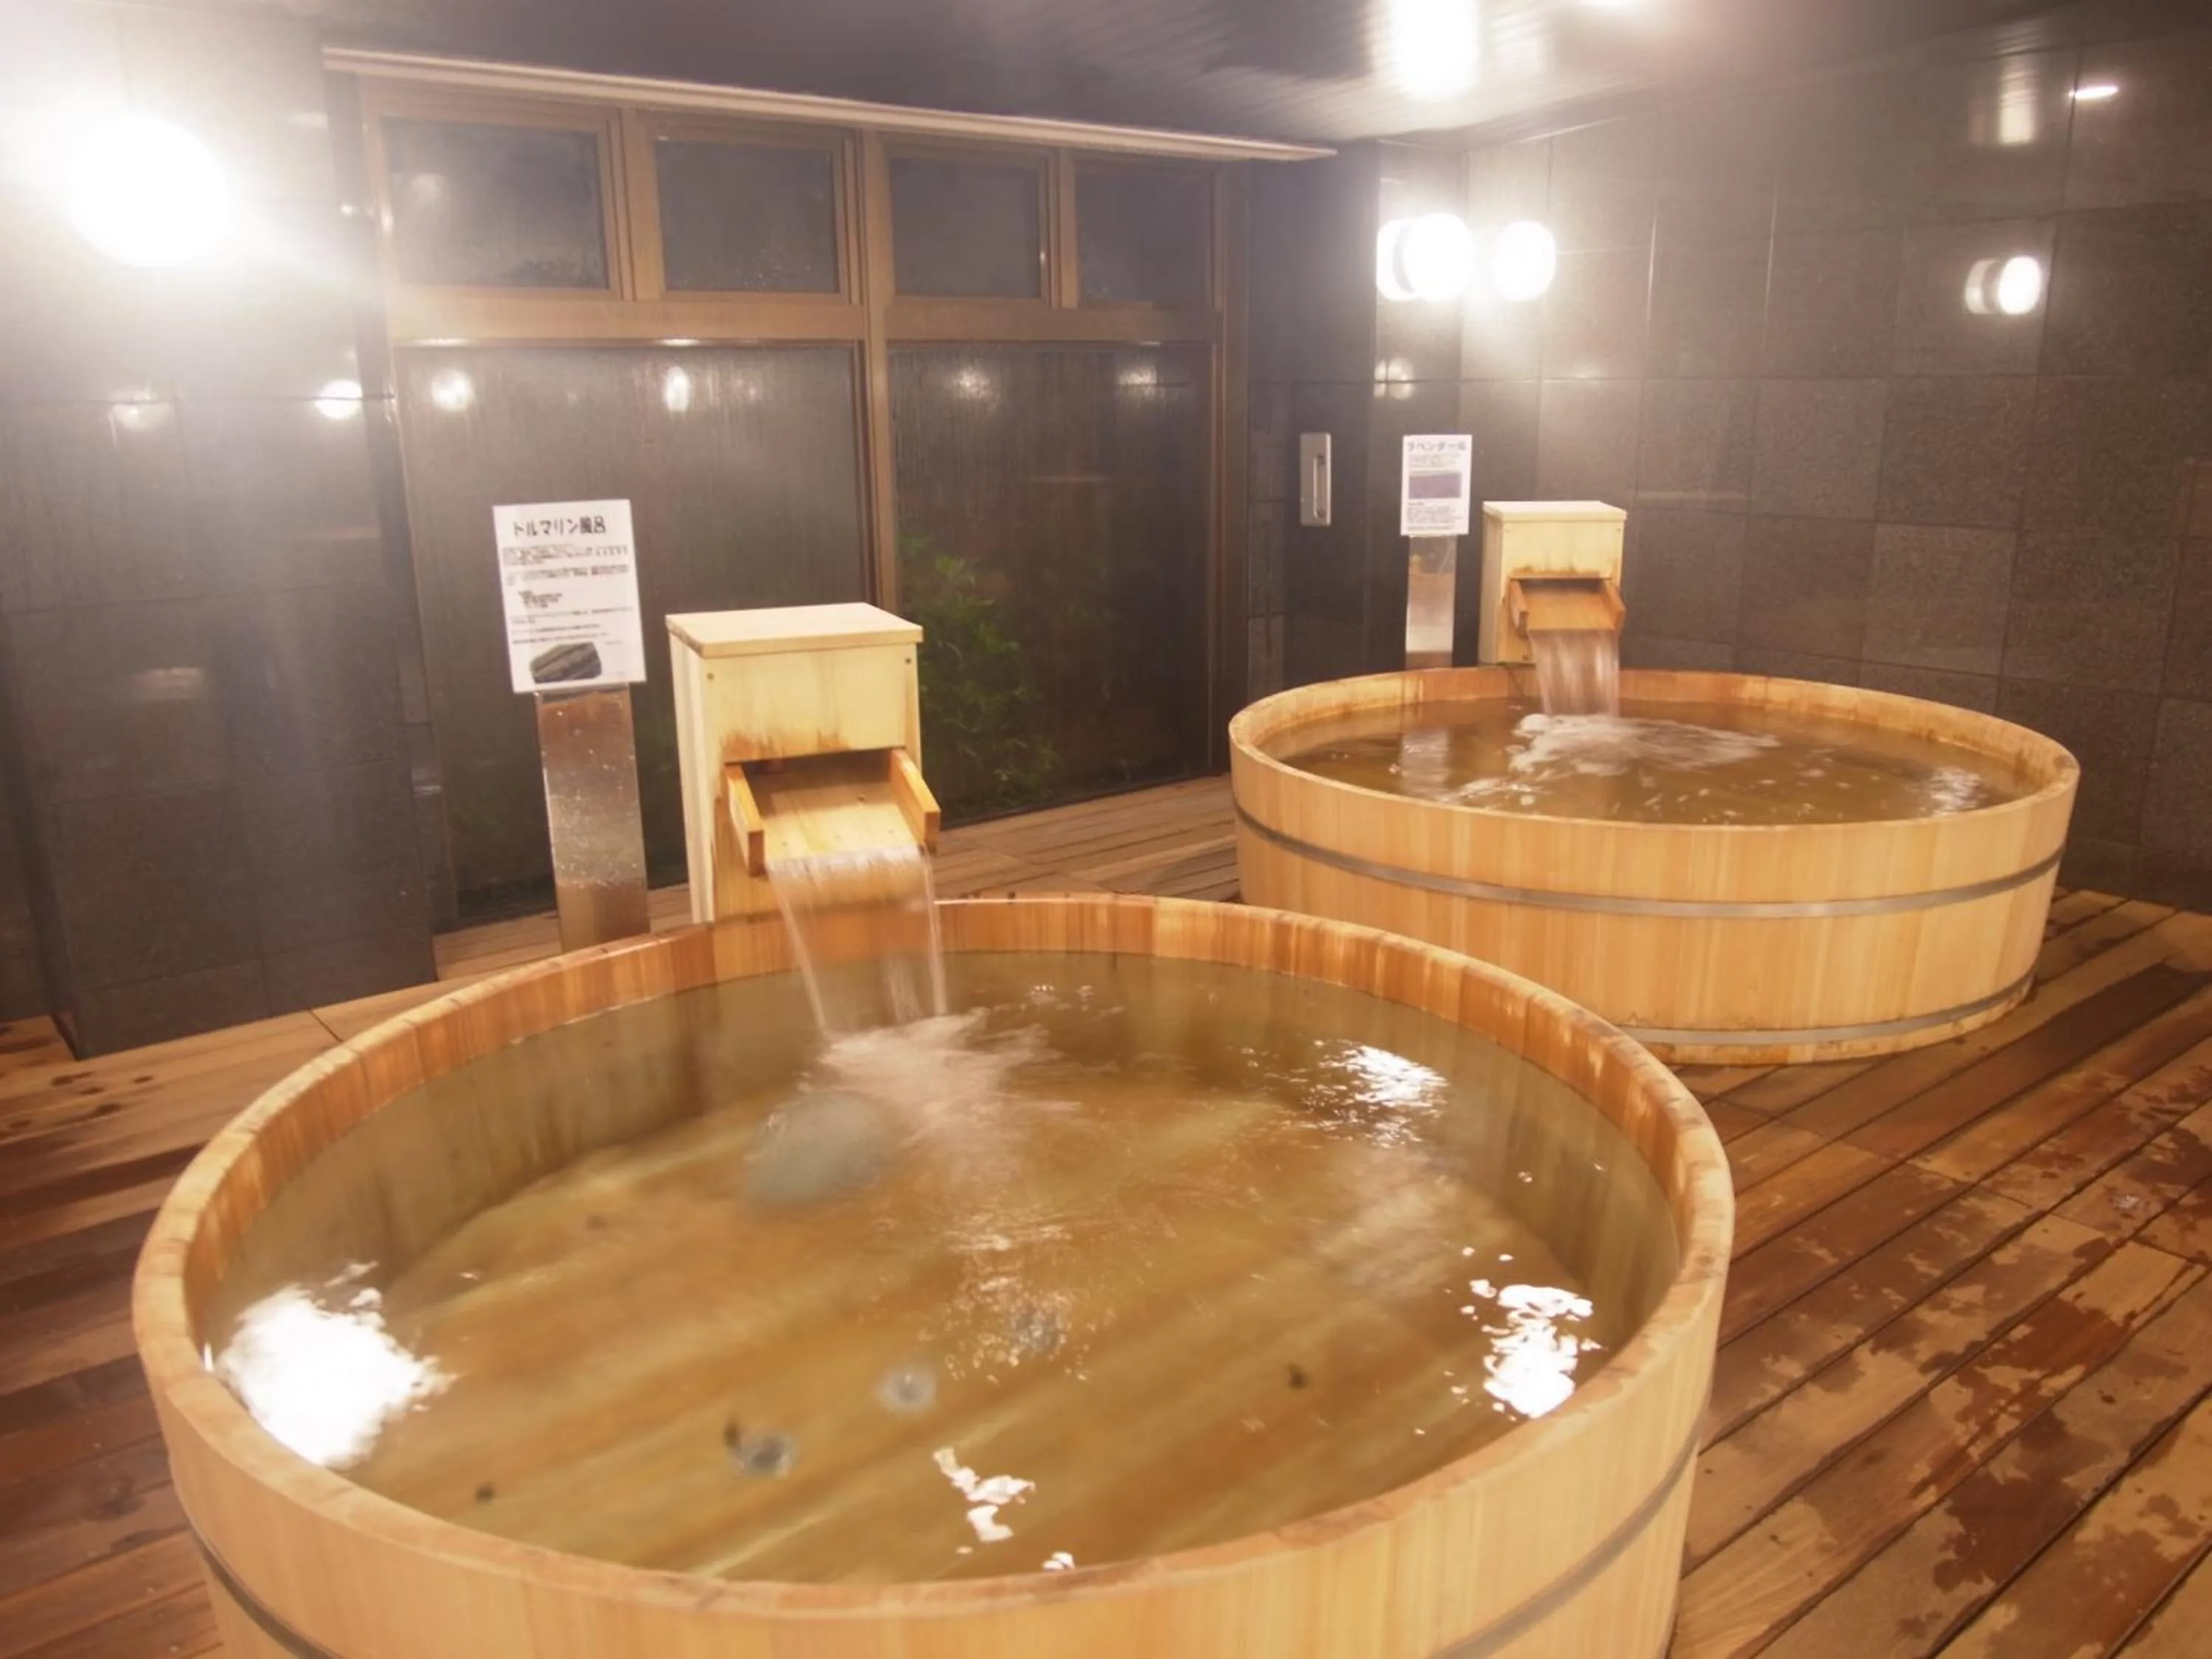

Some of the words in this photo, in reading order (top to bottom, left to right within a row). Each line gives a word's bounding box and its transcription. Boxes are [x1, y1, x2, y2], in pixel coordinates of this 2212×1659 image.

[513, 515, 605, 537] トルマリン風呂
